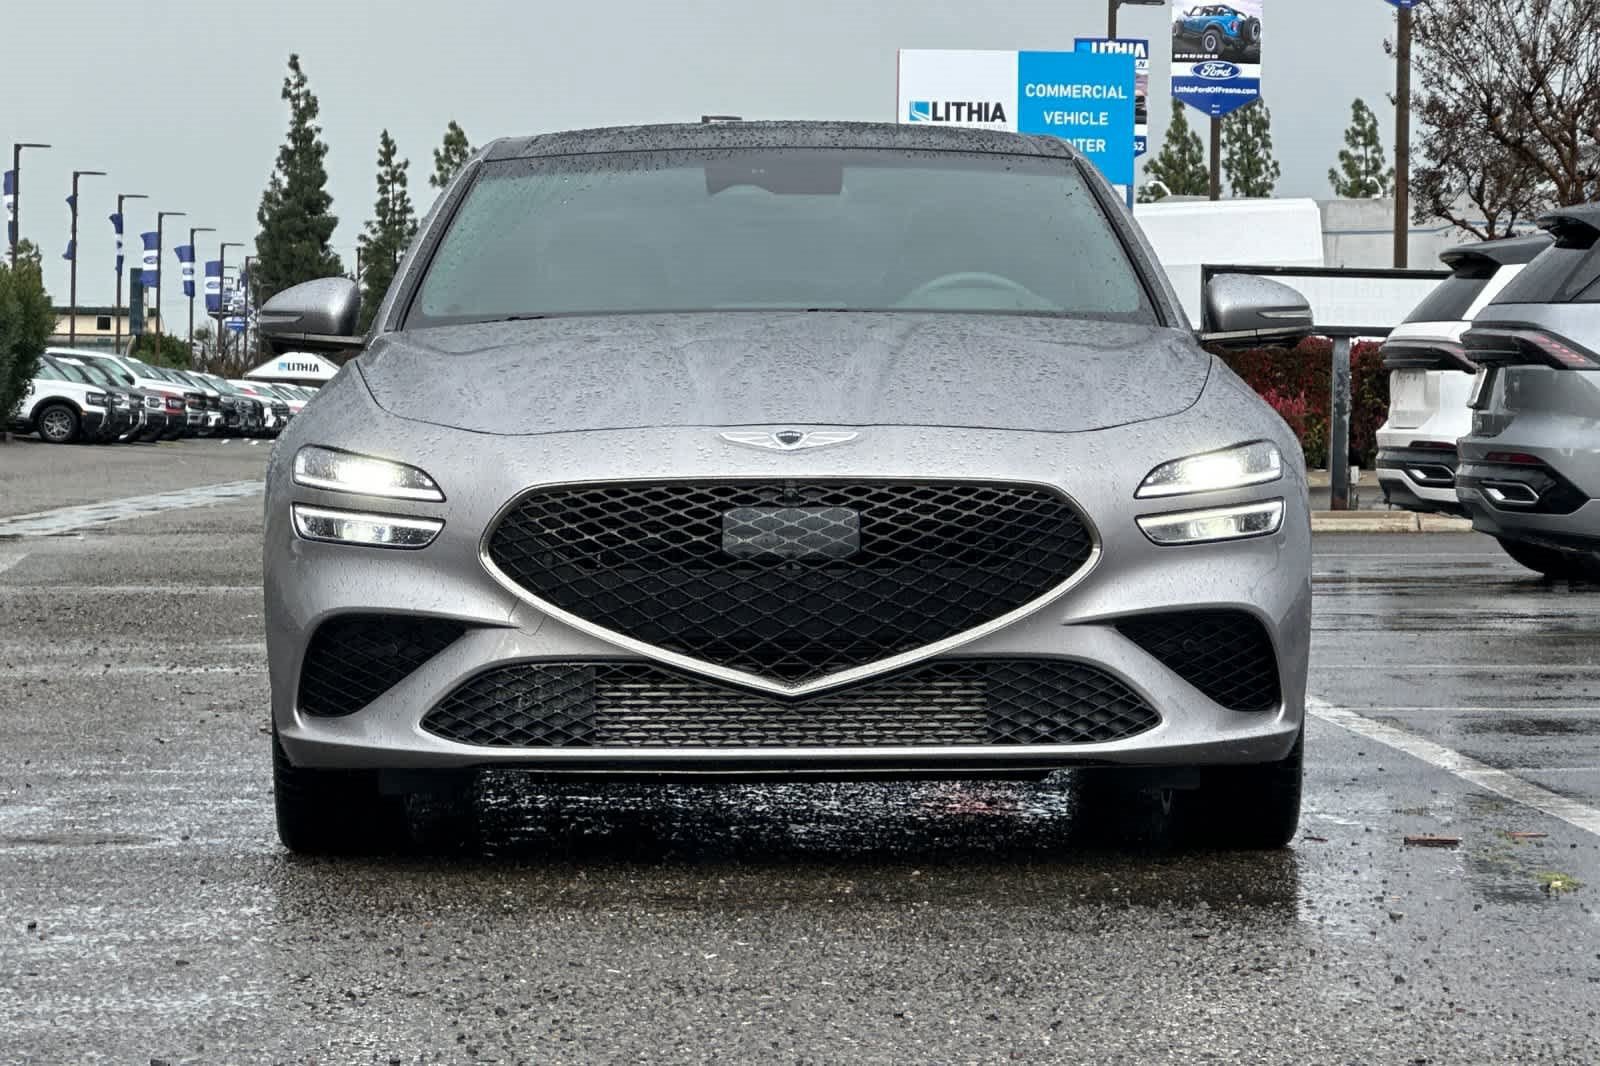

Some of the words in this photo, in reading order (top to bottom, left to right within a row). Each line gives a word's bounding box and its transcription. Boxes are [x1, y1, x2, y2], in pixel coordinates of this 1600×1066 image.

[1200, 63, 1231, 77] Ford
[1025, 83, 1128, 99] COMMERCIAL
[1174, 86, 1257, 95] LithiaFordOfFresno.com
[932, 101, 1006, 122] LITHIA
[1043, 111, 1109, 126] VEHICLE
[1066, 138, 1106, 153] NTER
[287, 362, 320, 373] LITHIA
